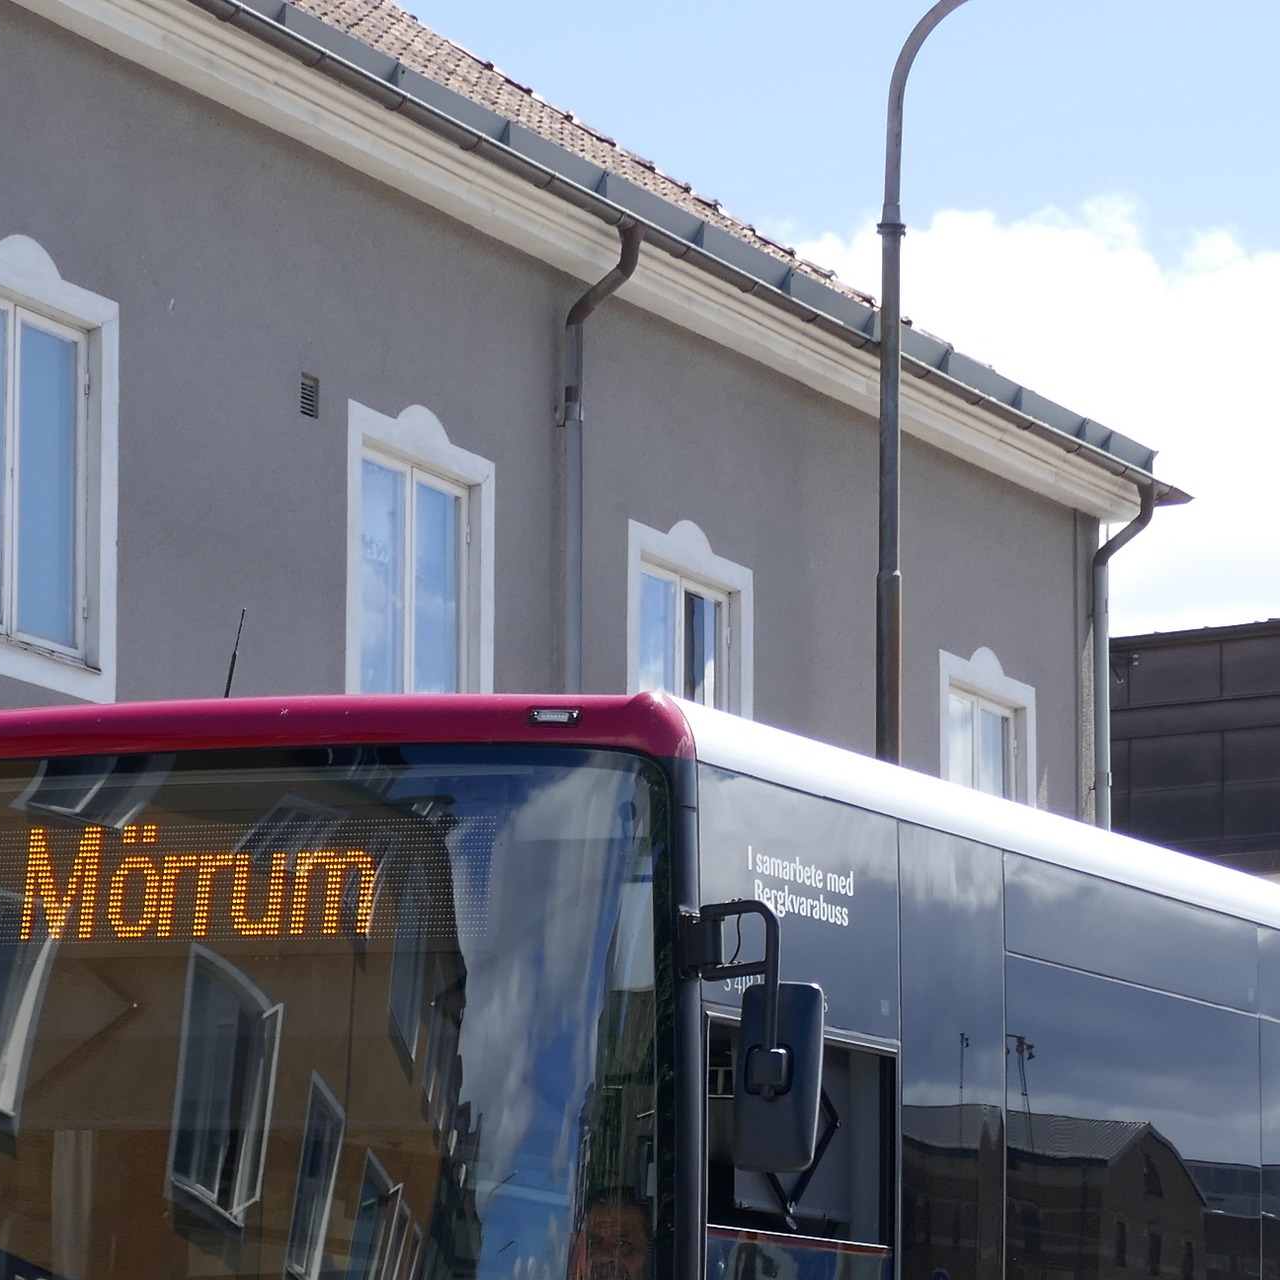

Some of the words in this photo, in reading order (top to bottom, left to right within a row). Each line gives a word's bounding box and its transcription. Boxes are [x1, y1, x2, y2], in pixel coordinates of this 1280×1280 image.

[20, 824, 377, 941] Mörrum
[747, 844, 753, 871] I
[755, 856, 824, 889] samarbete
[826, 870, 855, 897] med
[754, 879, 849, 927] Bergkvarabuss
